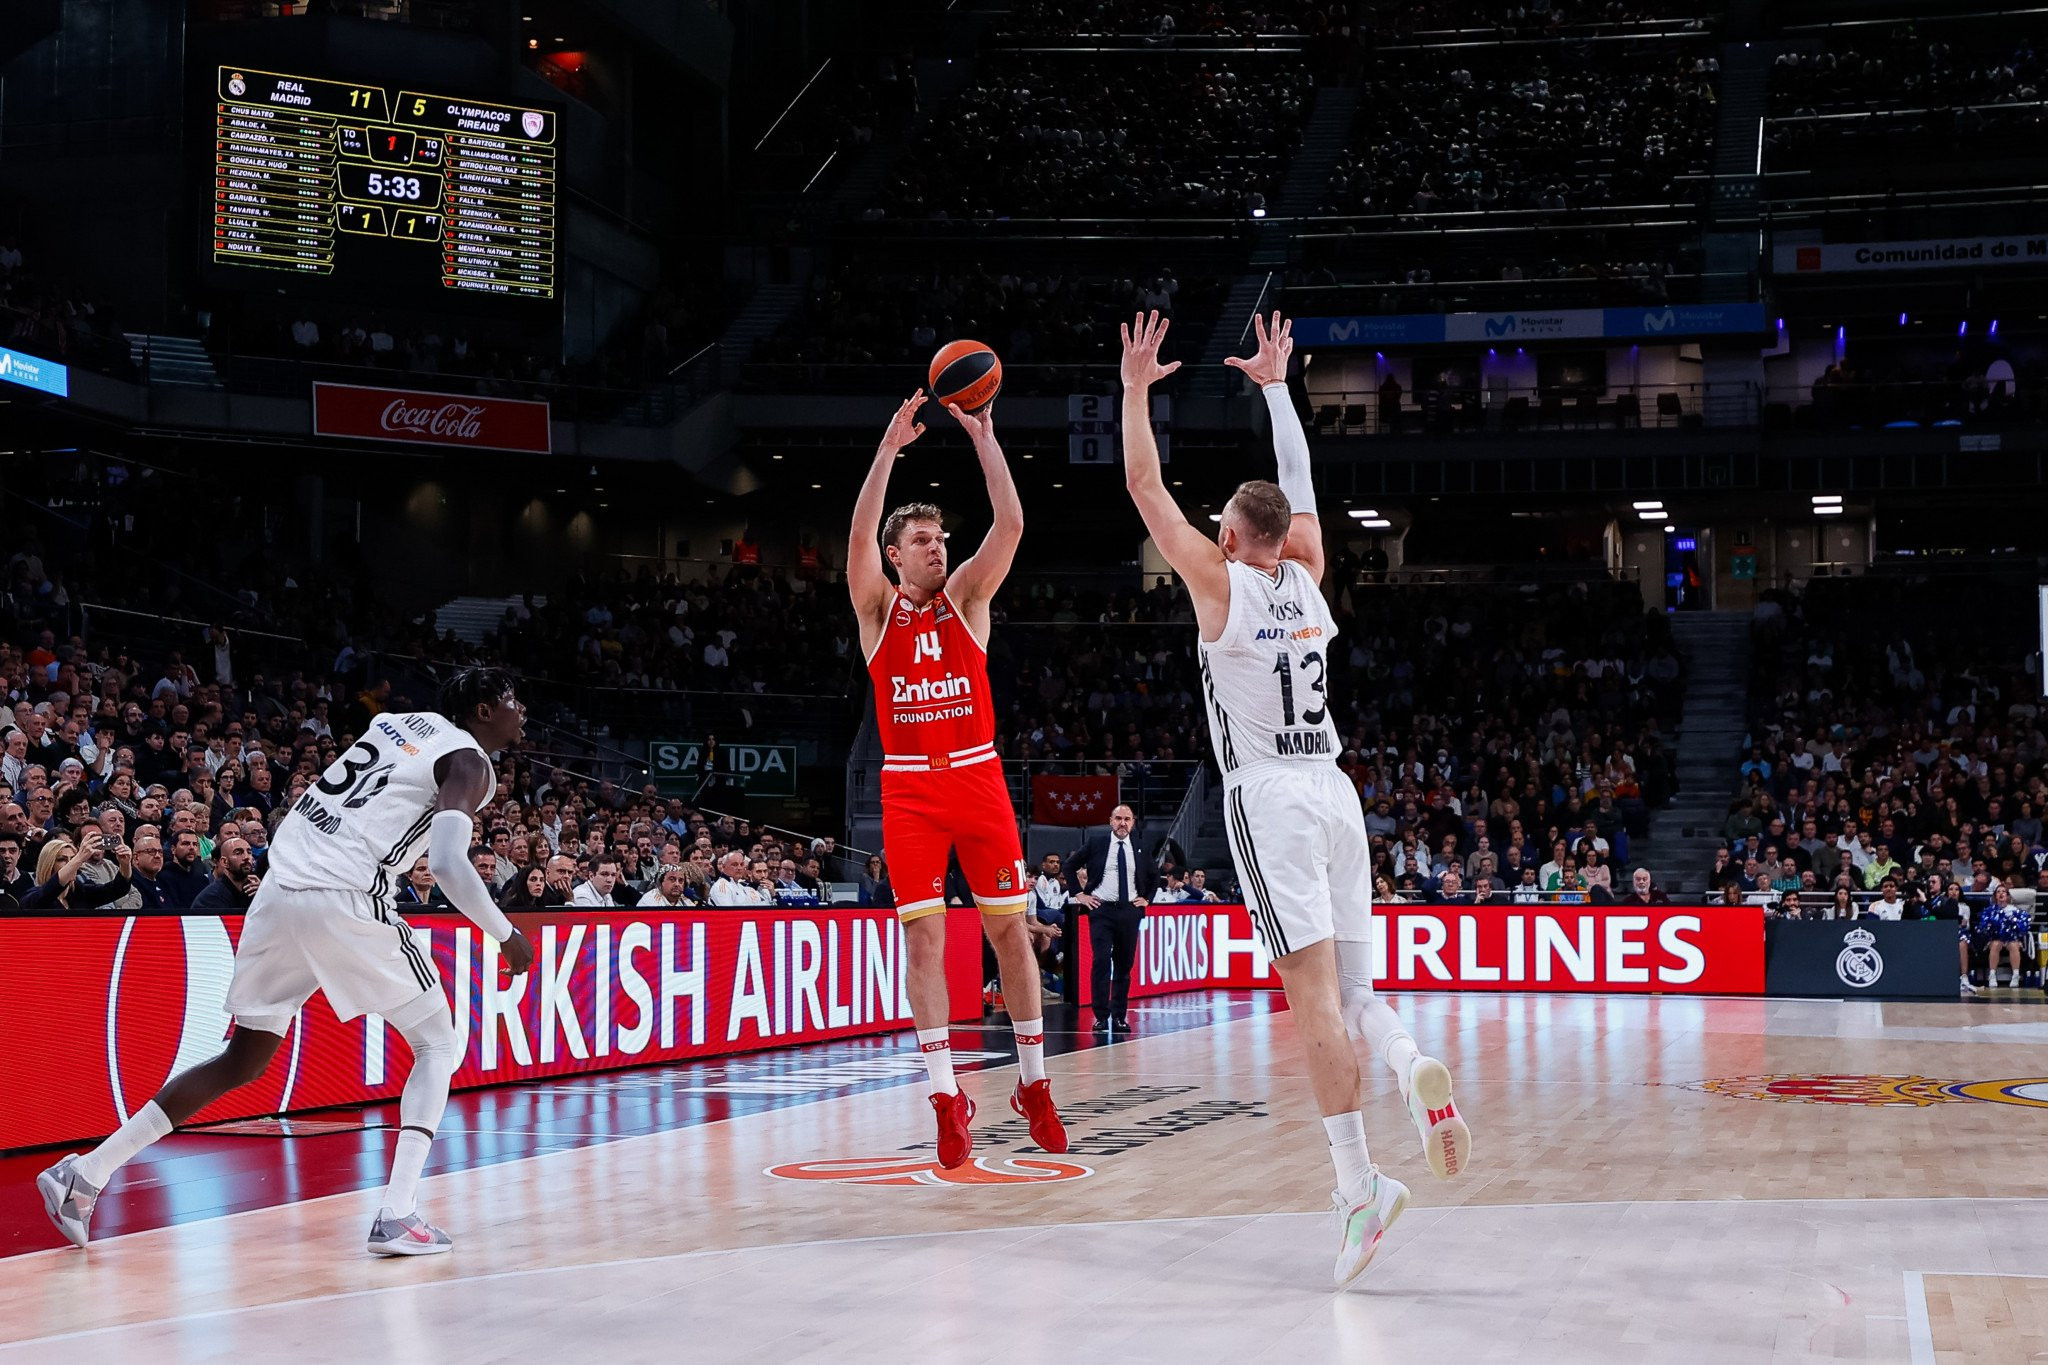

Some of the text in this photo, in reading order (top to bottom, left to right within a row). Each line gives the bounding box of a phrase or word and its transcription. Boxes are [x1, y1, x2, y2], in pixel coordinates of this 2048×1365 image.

[277, 81, 304, 93] REAL
[270, 92, 311, 106] MADRID
[349, 89, 371, 109] 11
[412, 98, 427, 116] 5
[250, 109, 275, 118] MATEO
[446, 105, 511, 122] OLYMPIACOS
[343, 128, 356, 139] TO
[457, 119, 500, 133] PIREAUS
[387, 135, 397, 151] 1
[425, 140, 438, 149] TO
[284, 150, 294, 158] XA
[267, 160, 288, 169] HUGO
[368, 172, 420, 200] 5:33
[342, 205, 354, 215] FT
[361, 212, 371, 229] 1
[407, 218, 416, 234] 1
[425, 215, 437, 225] FT
[1855, 242, 1983, 264] Comunidad
[1991, 241, 2018, 257] de
[491, 283, 509, 292] EVAN
[1521, 317, 1563, 327] Movistar
[13, 359, 39, 375] Movistar
[956, 376, 998, 406] PALDING
[1082, 396, 1097, 418] 2
[381, 398, 486, 438] Coca-Cola
[1082, 438, 1098, 460] 0
[913, 630, 943, 664] 14
[1271, 651, 1326, 727] 13
[892, 704, 974, 725] FOUNDATION
[400, 714, 440, 739] NDIAY
[1274, 731, 1331, 756] MADRID
[657, 745, 788, 774] SAIDA
[930, 756, 949, 768] 100
[314, 741, 398, 809] 30
[293, 792, 342, 835] MADRID
[1138, 913, 1706, 987] TURKISH IRLINES
[925, 1041, 949, 1052] GSA
[1440, 1129, 1459, 1176] HARIBO
